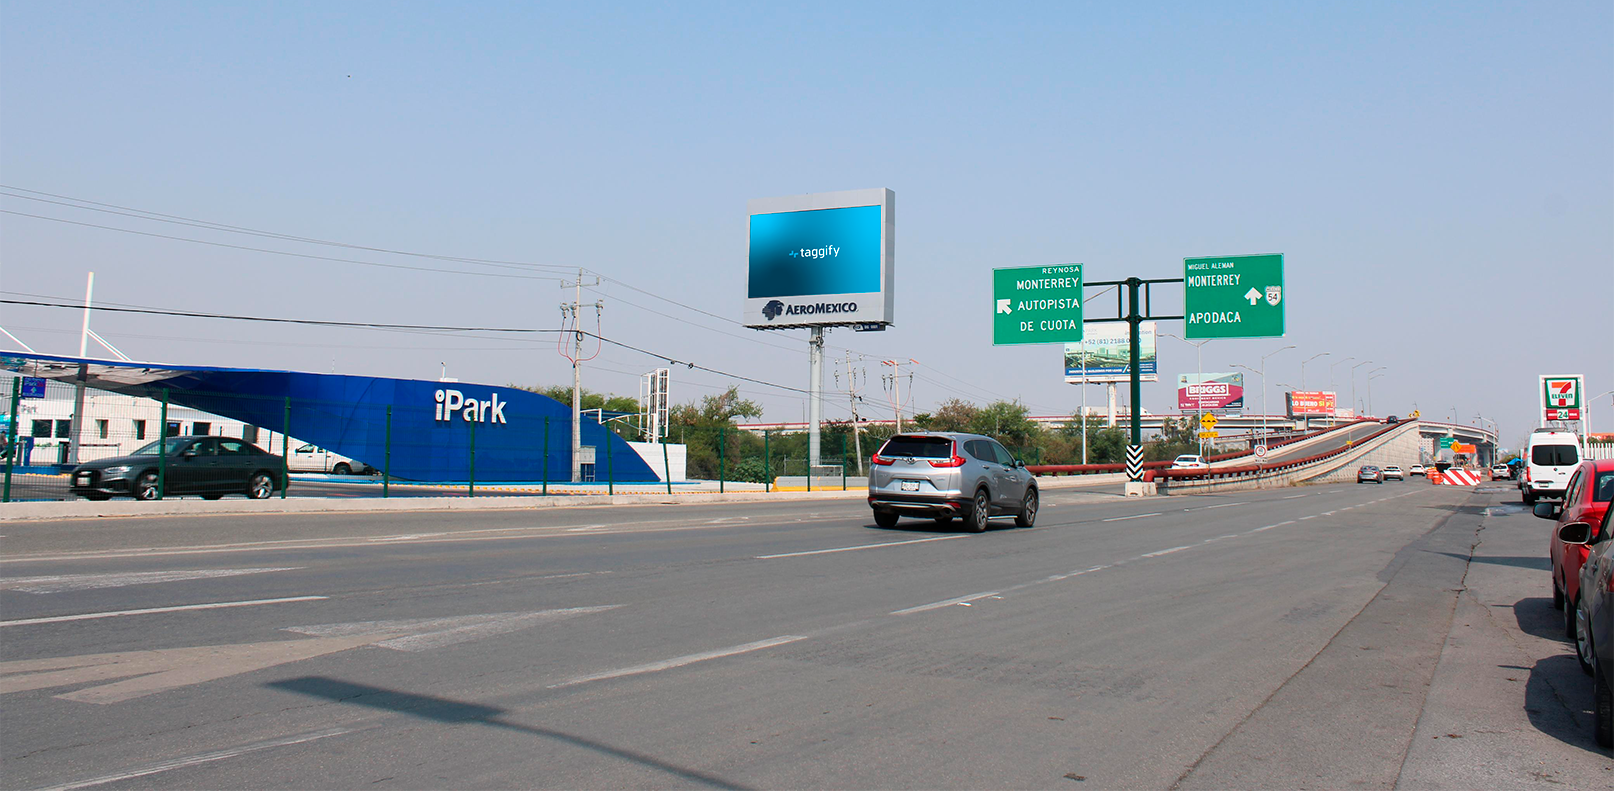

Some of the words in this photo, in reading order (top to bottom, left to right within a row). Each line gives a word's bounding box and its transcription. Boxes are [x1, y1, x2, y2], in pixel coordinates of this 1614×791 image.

[800, 244, 840, 259] taggify
[1042, 266, 1080, 274] REYNOSA
[1016, 277, 1079, 290] MONTERREY
[1188, 274, 1241, 287] MONTERREY
[1268, 293, 1277, 301] 54
[1018, 298, 1080, 310] AUTOPISTA
[1189, 311, 1242, 324] APODACA
[1020, 321, 1034, 331] DE
[1040, 319, 1077, 331] CUOTA
[435, 389, 507, 424] iPark
[1558, 411, 1569, 419] 24
